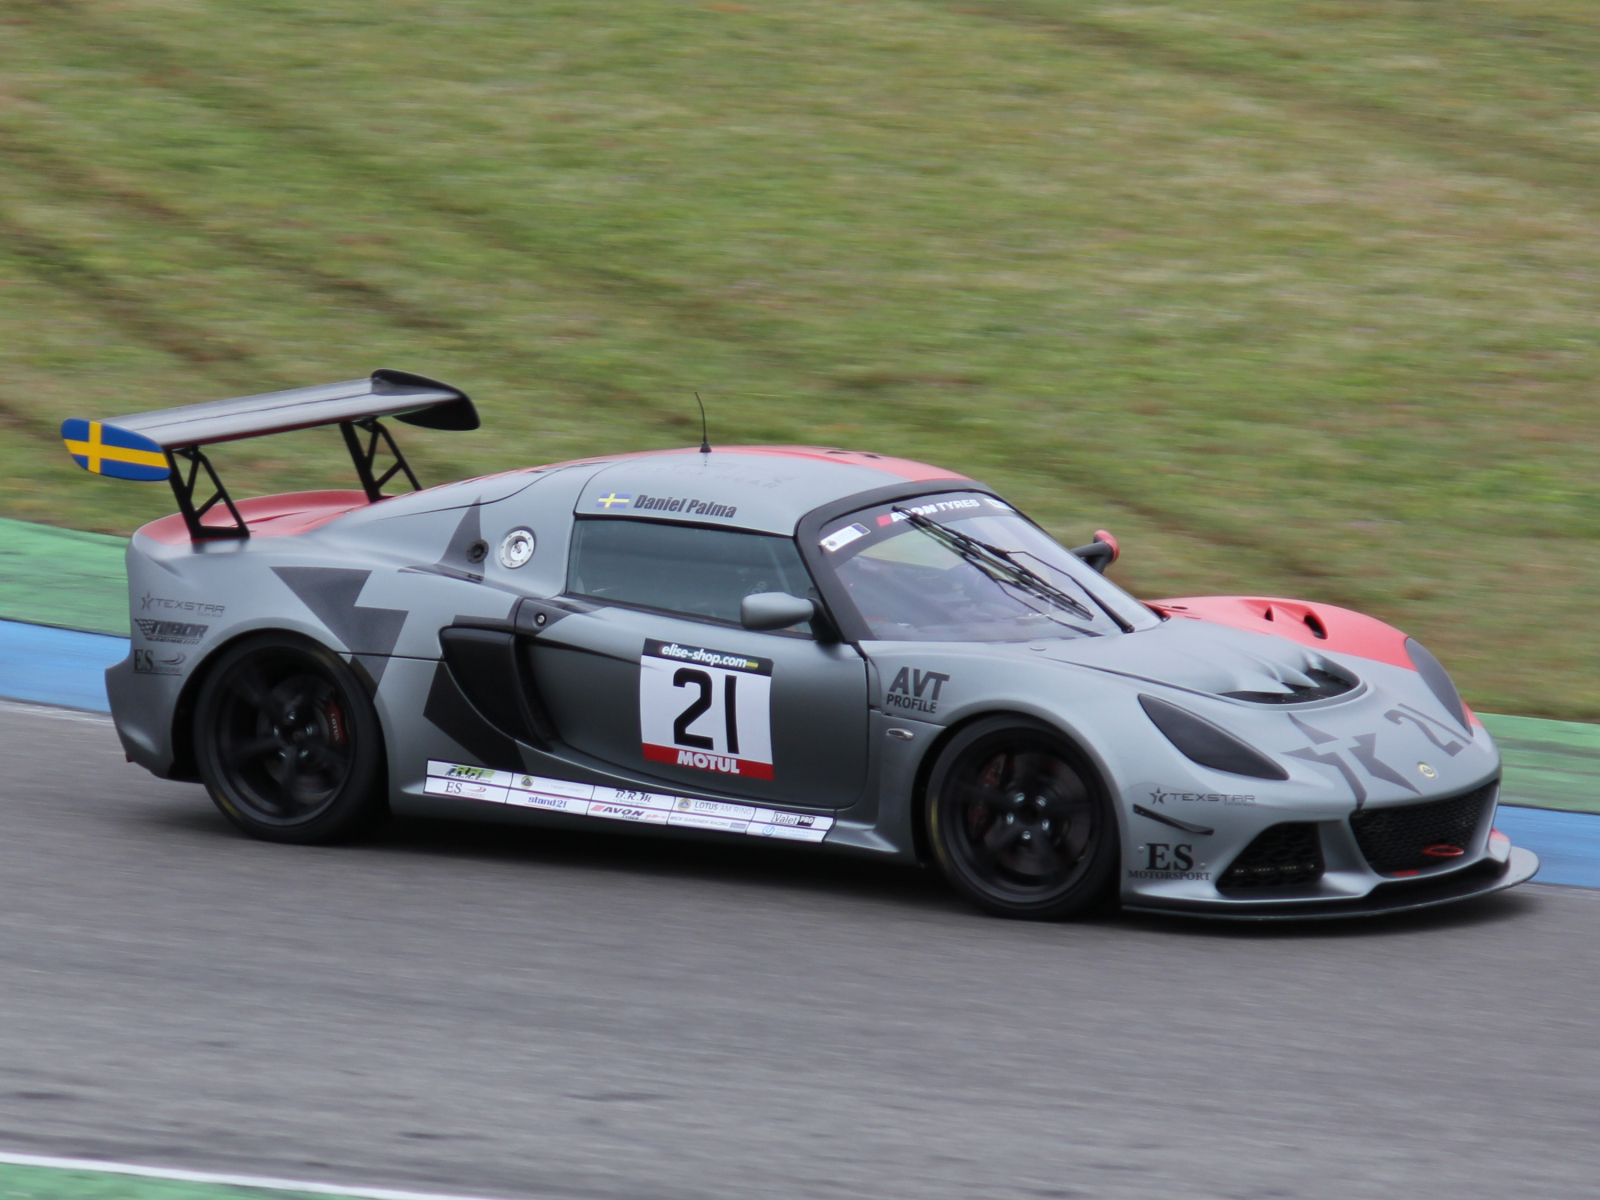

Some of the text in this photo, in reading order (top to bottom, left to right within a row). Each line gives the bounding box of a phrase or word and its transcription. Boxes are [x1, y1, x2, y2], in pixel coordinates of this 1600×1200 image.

[633, 494, 737, 518] Daniel Palma
[936, 499, 980, 511] TYRES
[155, 598, 225, 614] TEXSTAR
[134, 648, 154, 672] ES
[661, 643, 747, 668] elise-shop.com
[888, 665, 950, 701] AVT
[673, 667, 740, 754] 21
[886, 693, 937, 714] PROFILE
[1383, 702, 1473, 757] 21
[677, 750, 740, 774] MOTUL
[445, 780, 463, 794] ES
[1169, 792, 1257, 803] TEXSTAR
[602, 806, 645, 816] AVON
[694, 801, 718, 811] LOTUS
[720, 804, 732, 813] AM
[733, 805, 752, 815] RING
[1145, 842, 1195, 872] ES
[1128, 869, 1211, 881] MOTORSPORT
